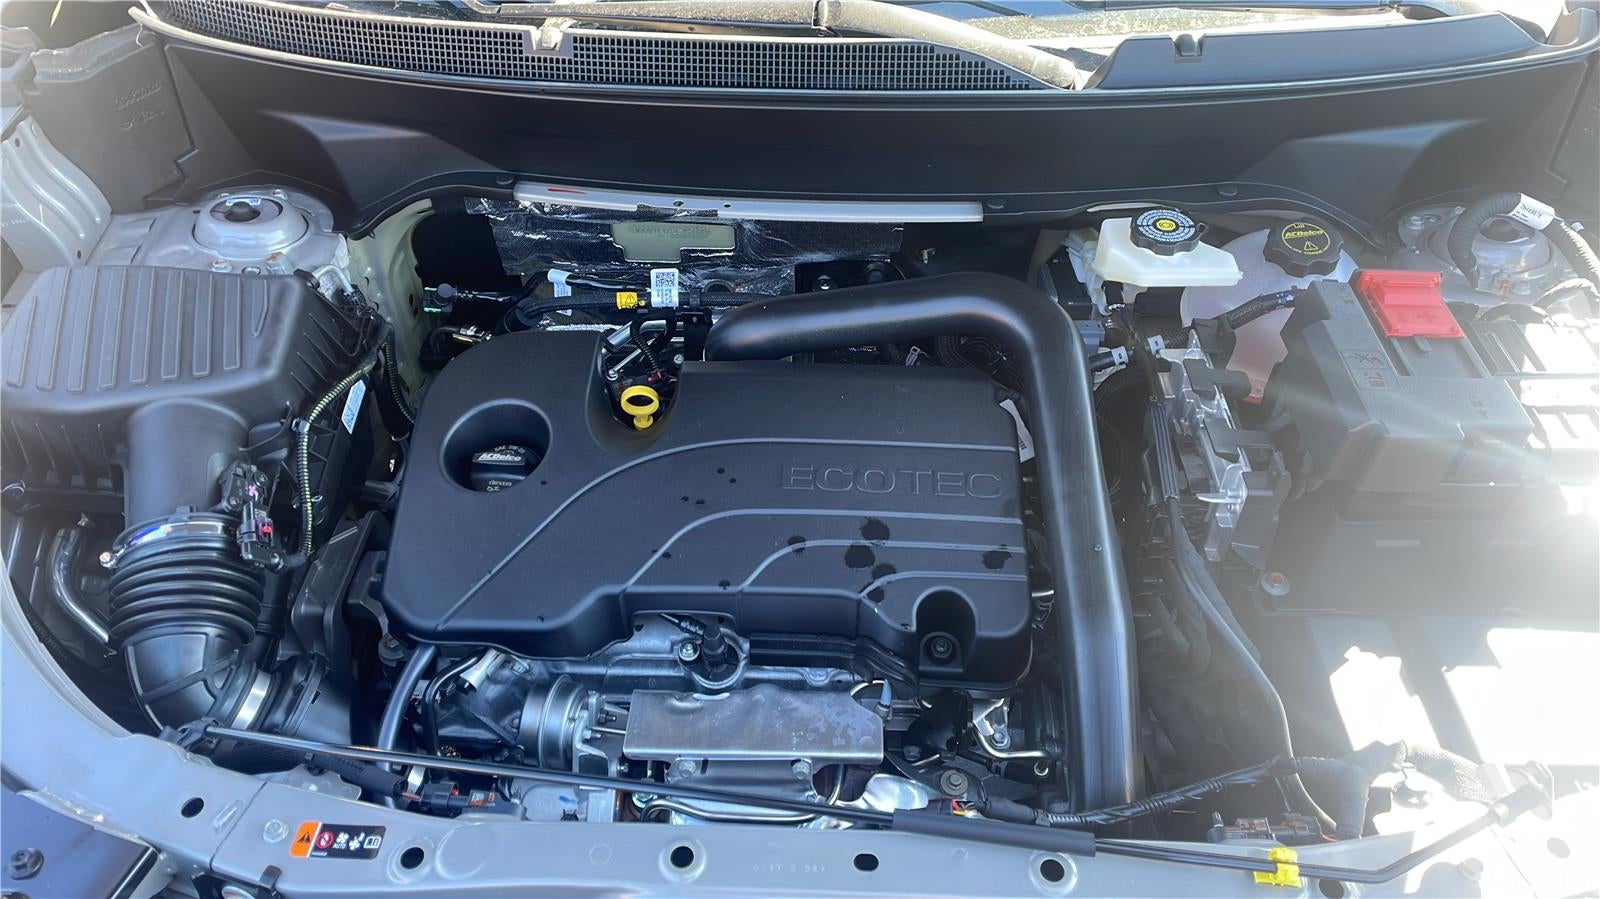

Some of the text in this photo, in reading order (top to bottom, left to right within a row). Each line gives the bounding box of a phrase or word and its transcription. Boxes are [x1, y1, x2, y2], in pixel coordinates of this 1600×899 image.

[1284, 229, 1323, 239] ACDelco
[477, 453, 522, 461] ACDelco
[781, 464, 1003, 498] ECOTEC
